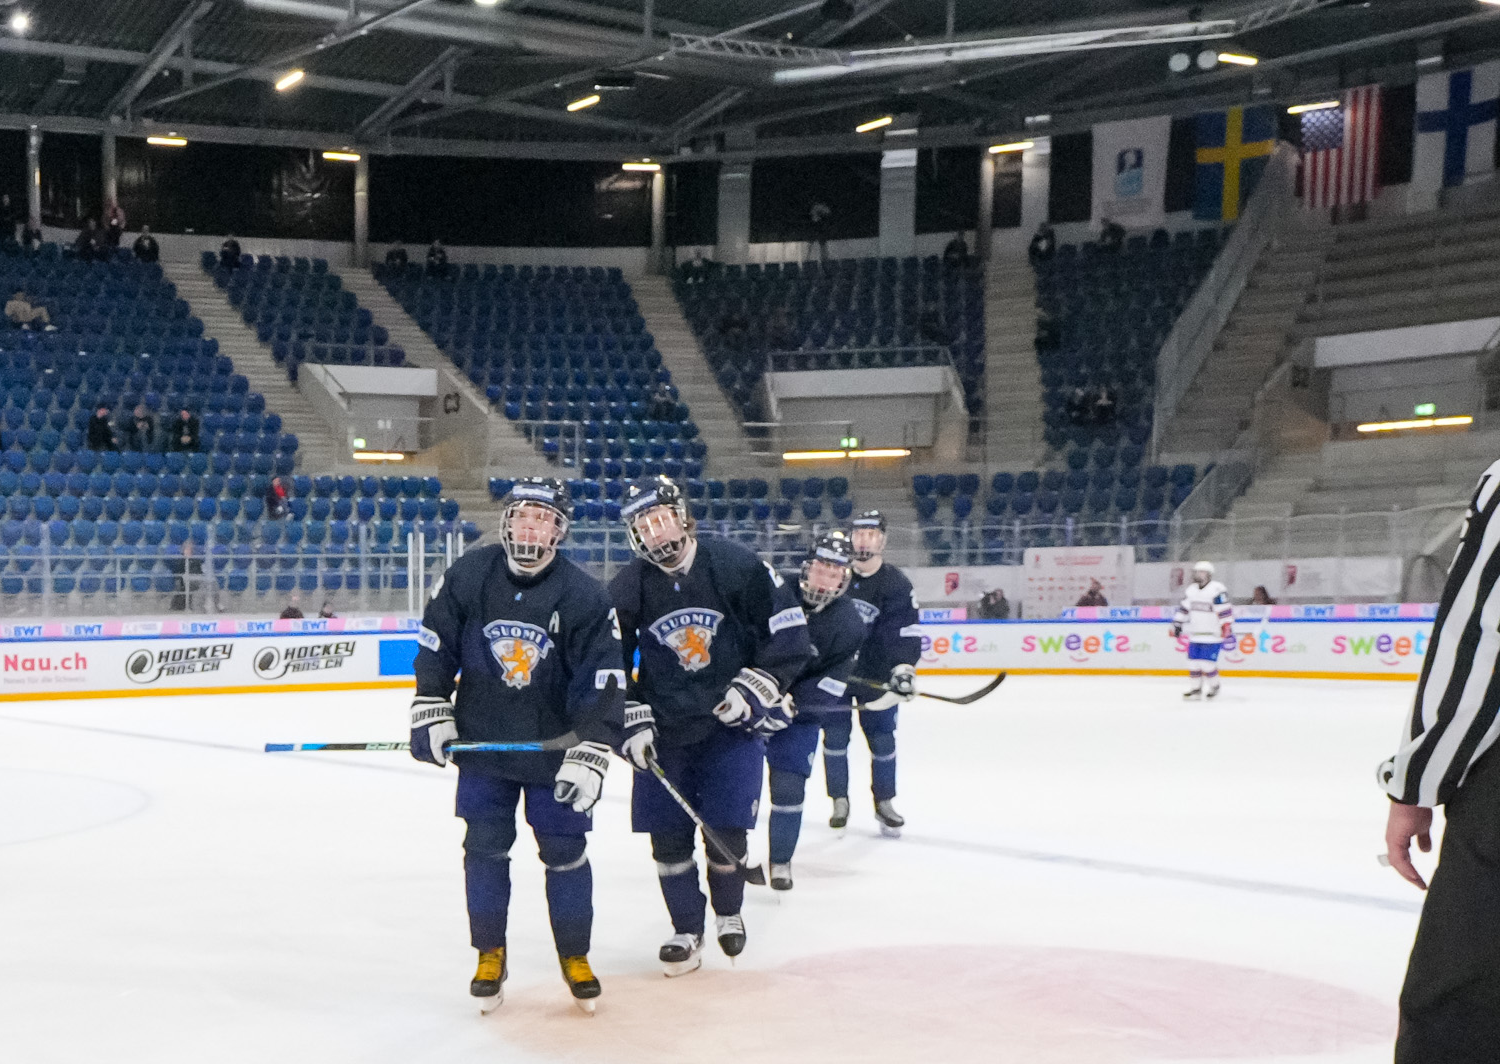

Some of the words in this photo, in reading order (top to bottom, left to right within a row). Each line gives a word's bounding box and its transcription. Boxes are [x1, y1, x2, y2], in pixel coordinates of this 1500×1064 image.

[923, 609, 952, 619] BWT
[1109, 608, 1140, 617] BWT
[190, 622, 218, 633] BWT
[247, 621, 274, 632] BWT
[302, 620, 328, 631] BWT
[549, 610, 560, 634] A
[660, 613, 714, 634] SUOMI
[13, 626, 44, 637] BWT
[74, 624, 103, 637] BWT
[490, 626, 543, 644] SUOMI
[1330, 629, 1432, 656] sweet
[157, 643, 234, 663] HOCKEY
[284, 640, 356, 661] HOCKEY
[3, 652, 88, 672] Nau.ch
